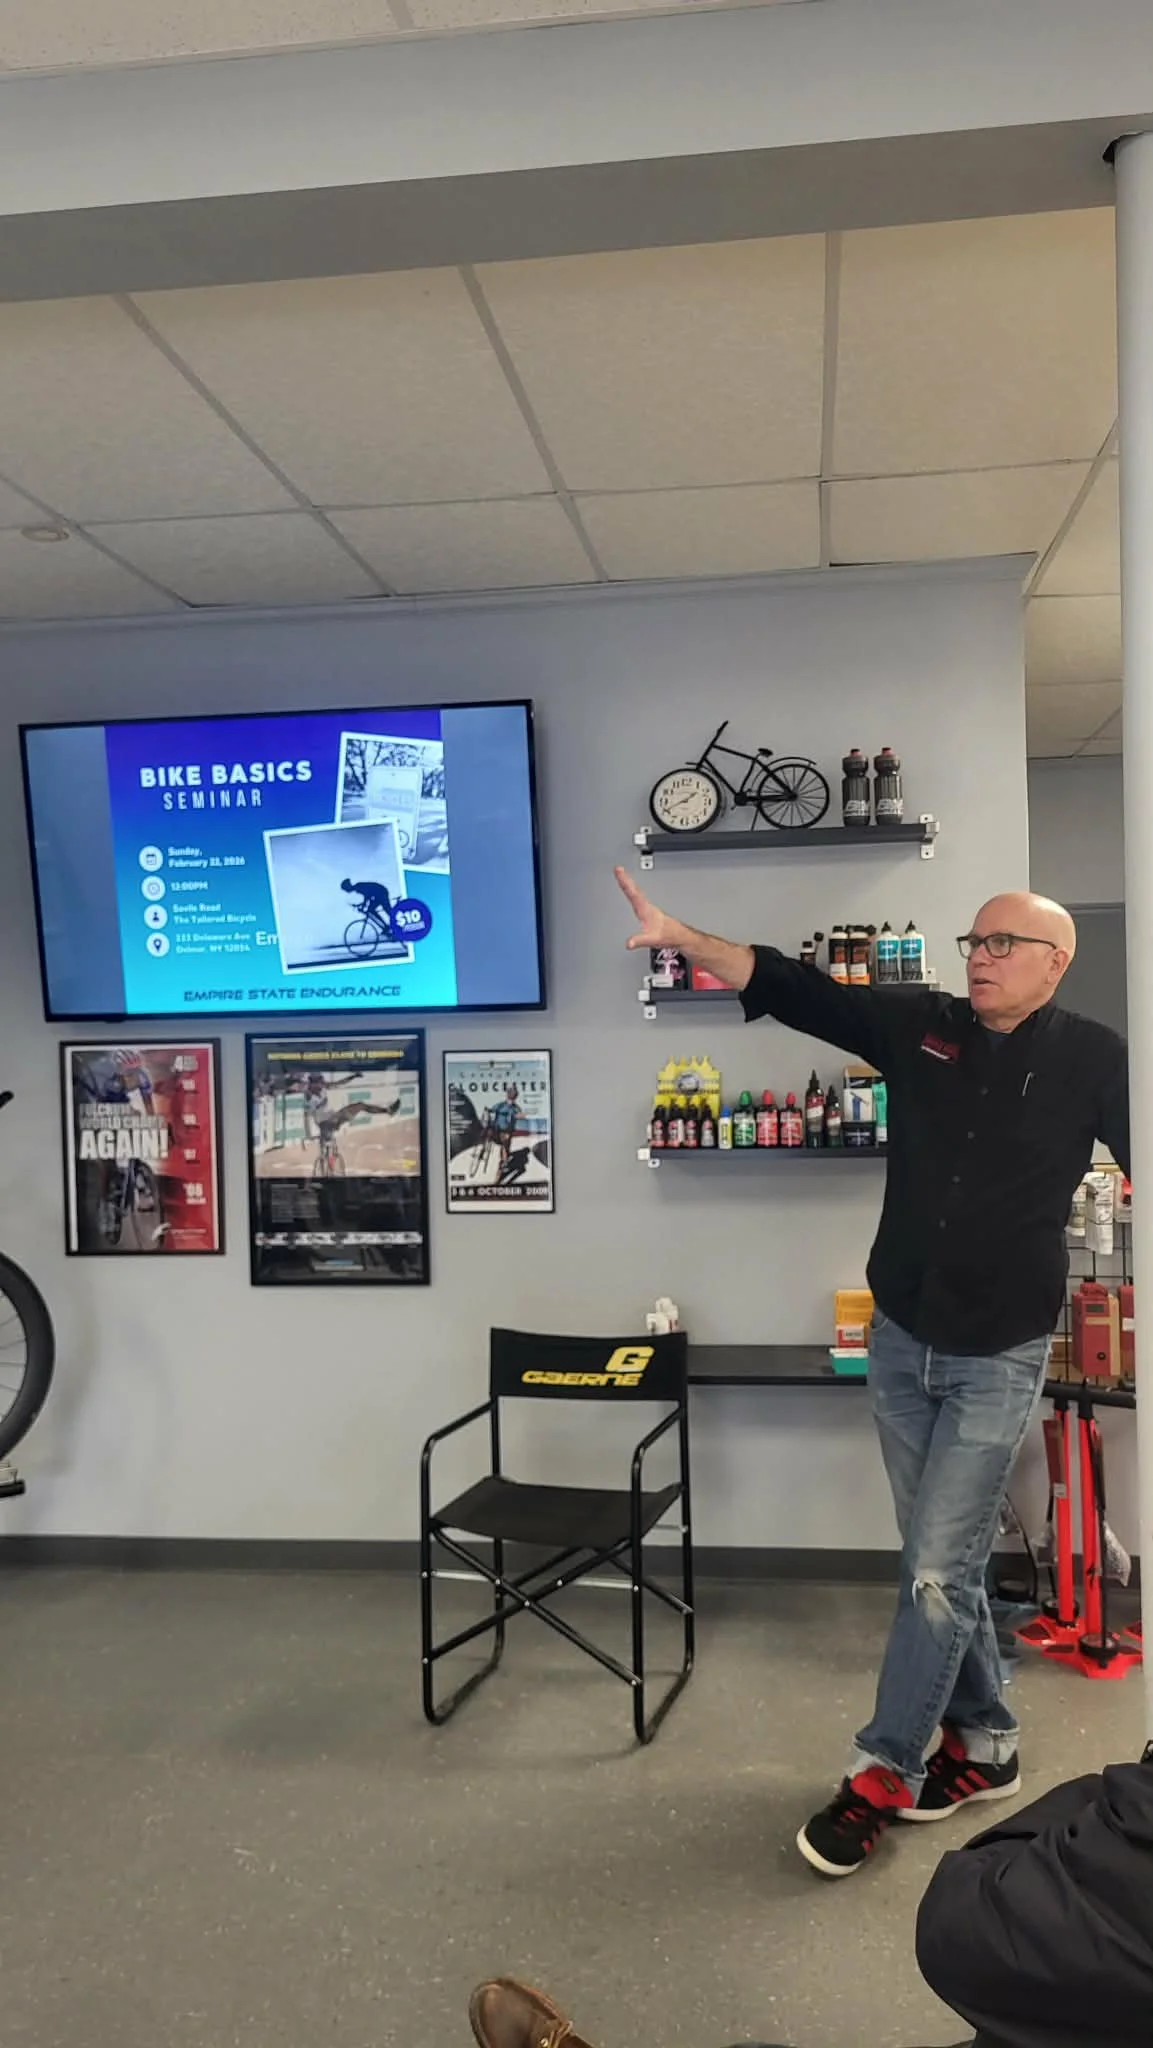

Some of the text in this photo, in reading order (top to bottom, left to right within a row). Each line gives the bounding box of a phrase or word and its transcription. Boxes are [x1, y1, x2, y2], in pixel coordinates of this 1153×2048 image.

[140, 760, 312, 788] BIKE BASICS
[163, 788, 262, 811] SEMINAR
[167, 846, 203, 857] Sunday,
[168, 858, 208, 869] February
[171, 881, 209, 892] 12:00PM
[174, 915, 189, 924] The
[227, 913, 256, 924] Bicycle
[395, 909, 421, 927] $10
[183, 985, 401, 1002] EMPIRE STATE ENDURANCE
[79, 1128, 169, 1160] AGAIN!
[477, 1185, 522, 1197] OCTOBER
[605, 1345, 656, 1373] G
[521, 1370, 645, 1387] GAERNE
